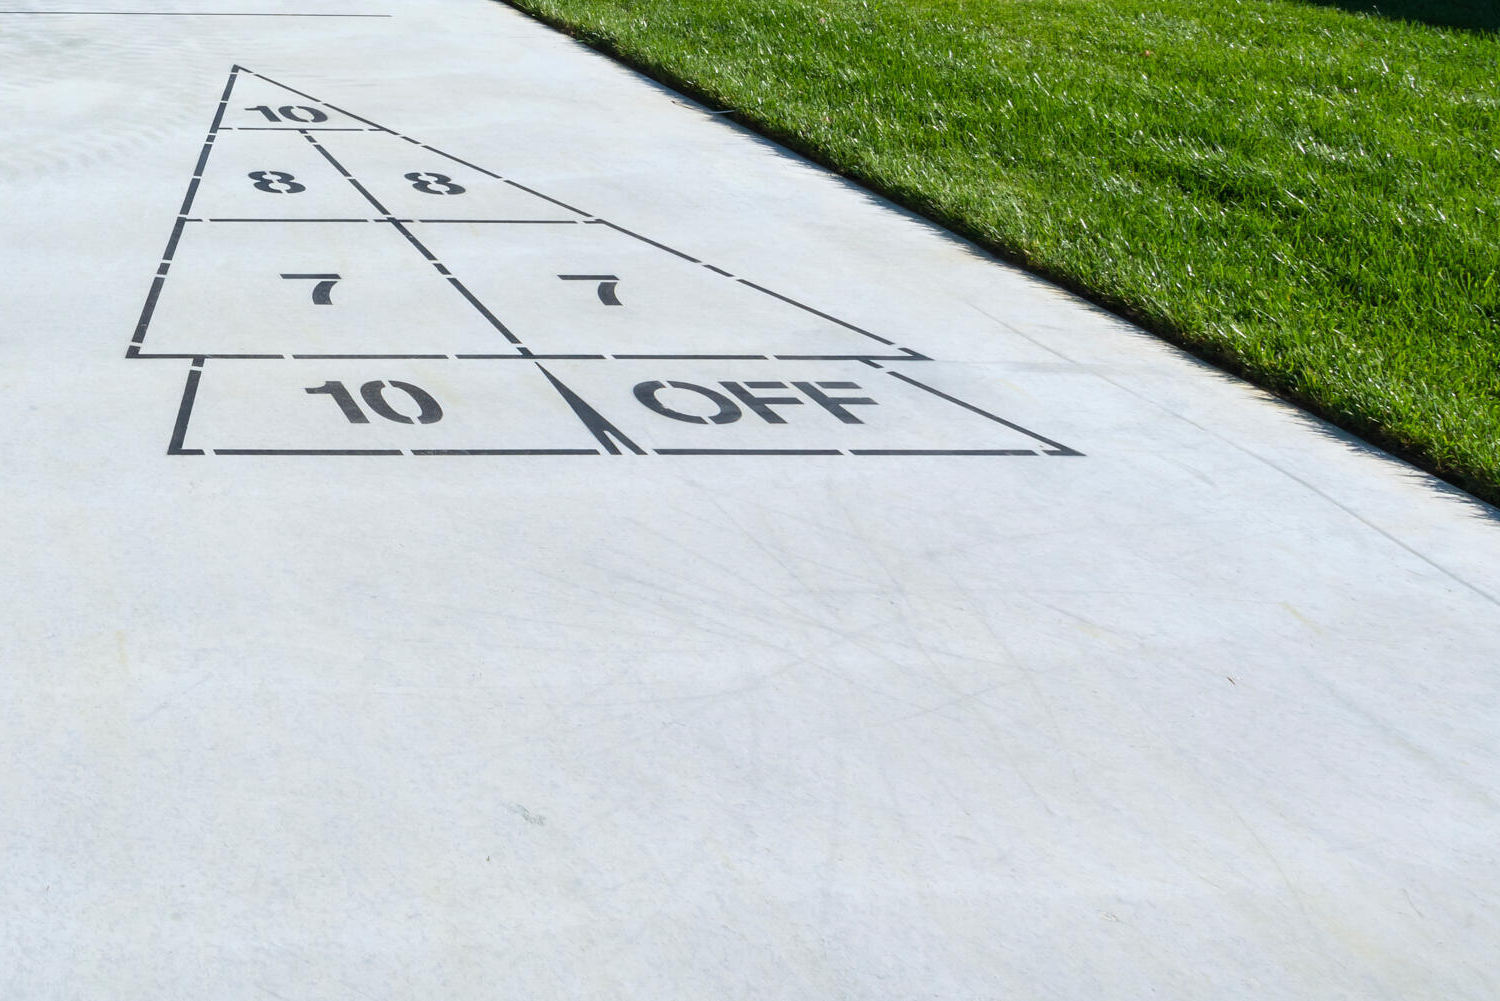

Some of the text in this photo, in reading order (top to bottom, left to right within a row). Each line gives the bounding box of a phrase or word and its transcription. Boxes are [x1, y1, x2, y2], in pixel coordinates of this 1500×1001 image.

[245, 105, 328, 123] 10
[248, 171, 466, 195] 8 8
[279, 273, 622, 306] 7 7
[304, 380, 879, 425] 10 OFF
